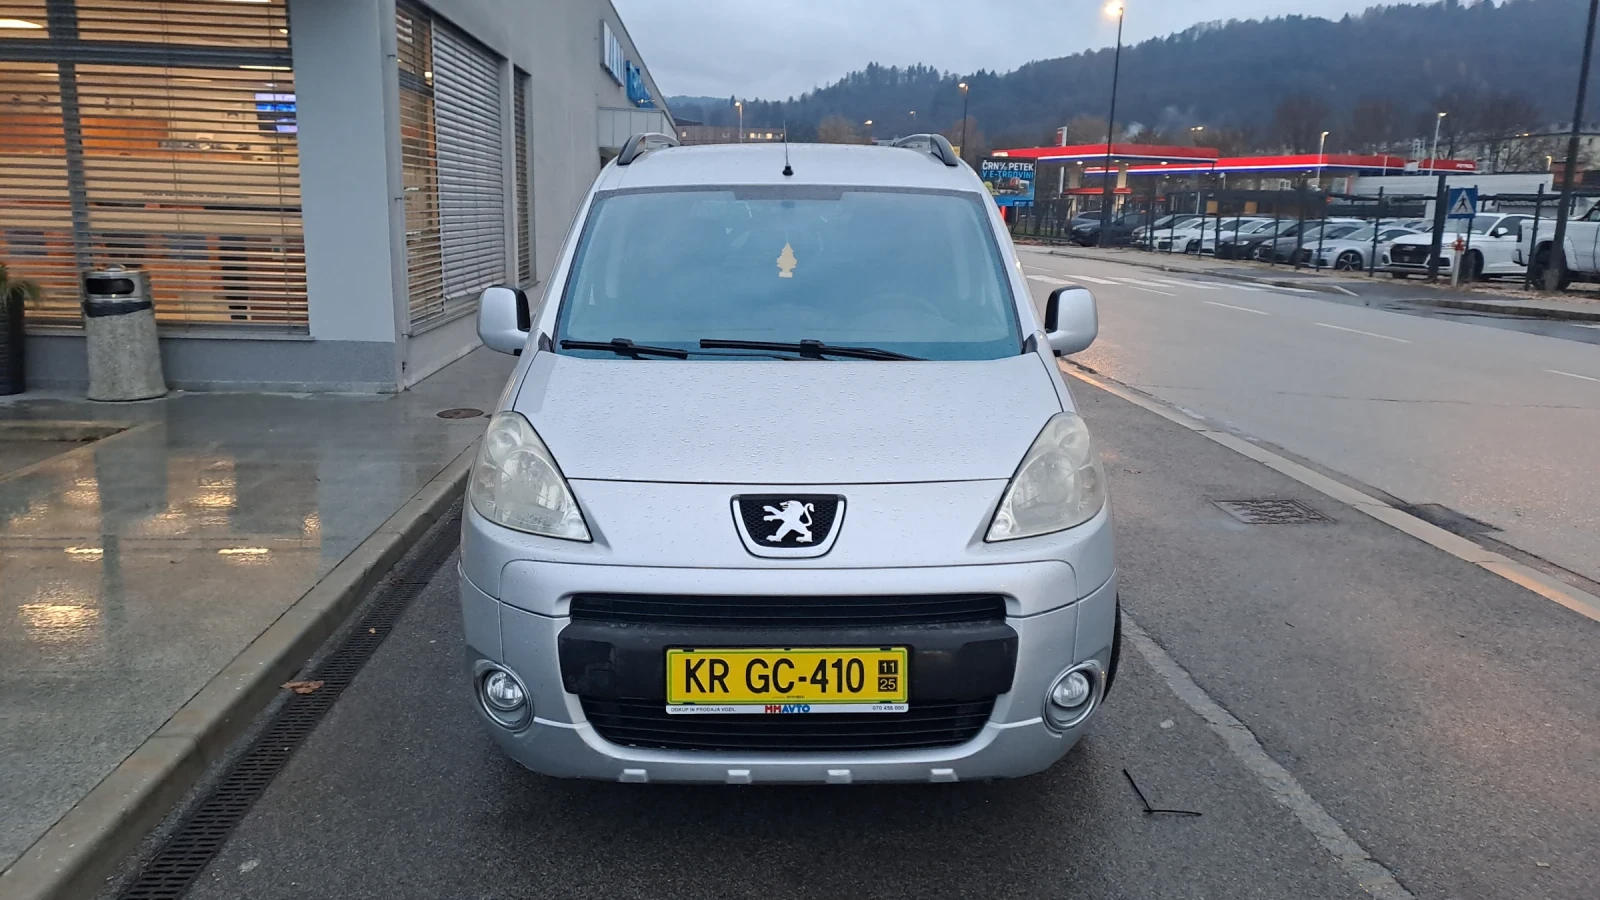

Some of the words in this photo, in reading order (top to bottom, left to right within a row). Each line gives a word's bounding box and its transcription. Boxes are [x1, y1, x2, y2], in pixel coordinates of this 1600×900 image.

[1008, 162, 1034, 171] PETEK
[982, 170, 988, 178] V
[989, 170, 1034, 179] E-TRGOVINI
[881, 662, 896, 673] 11
[685, 658, 730, 693] KR
[745, 658, 865, 694] GC-410
[880, 678, 896, 690] 25
[765, 704, 811, 713] MMAVTO
